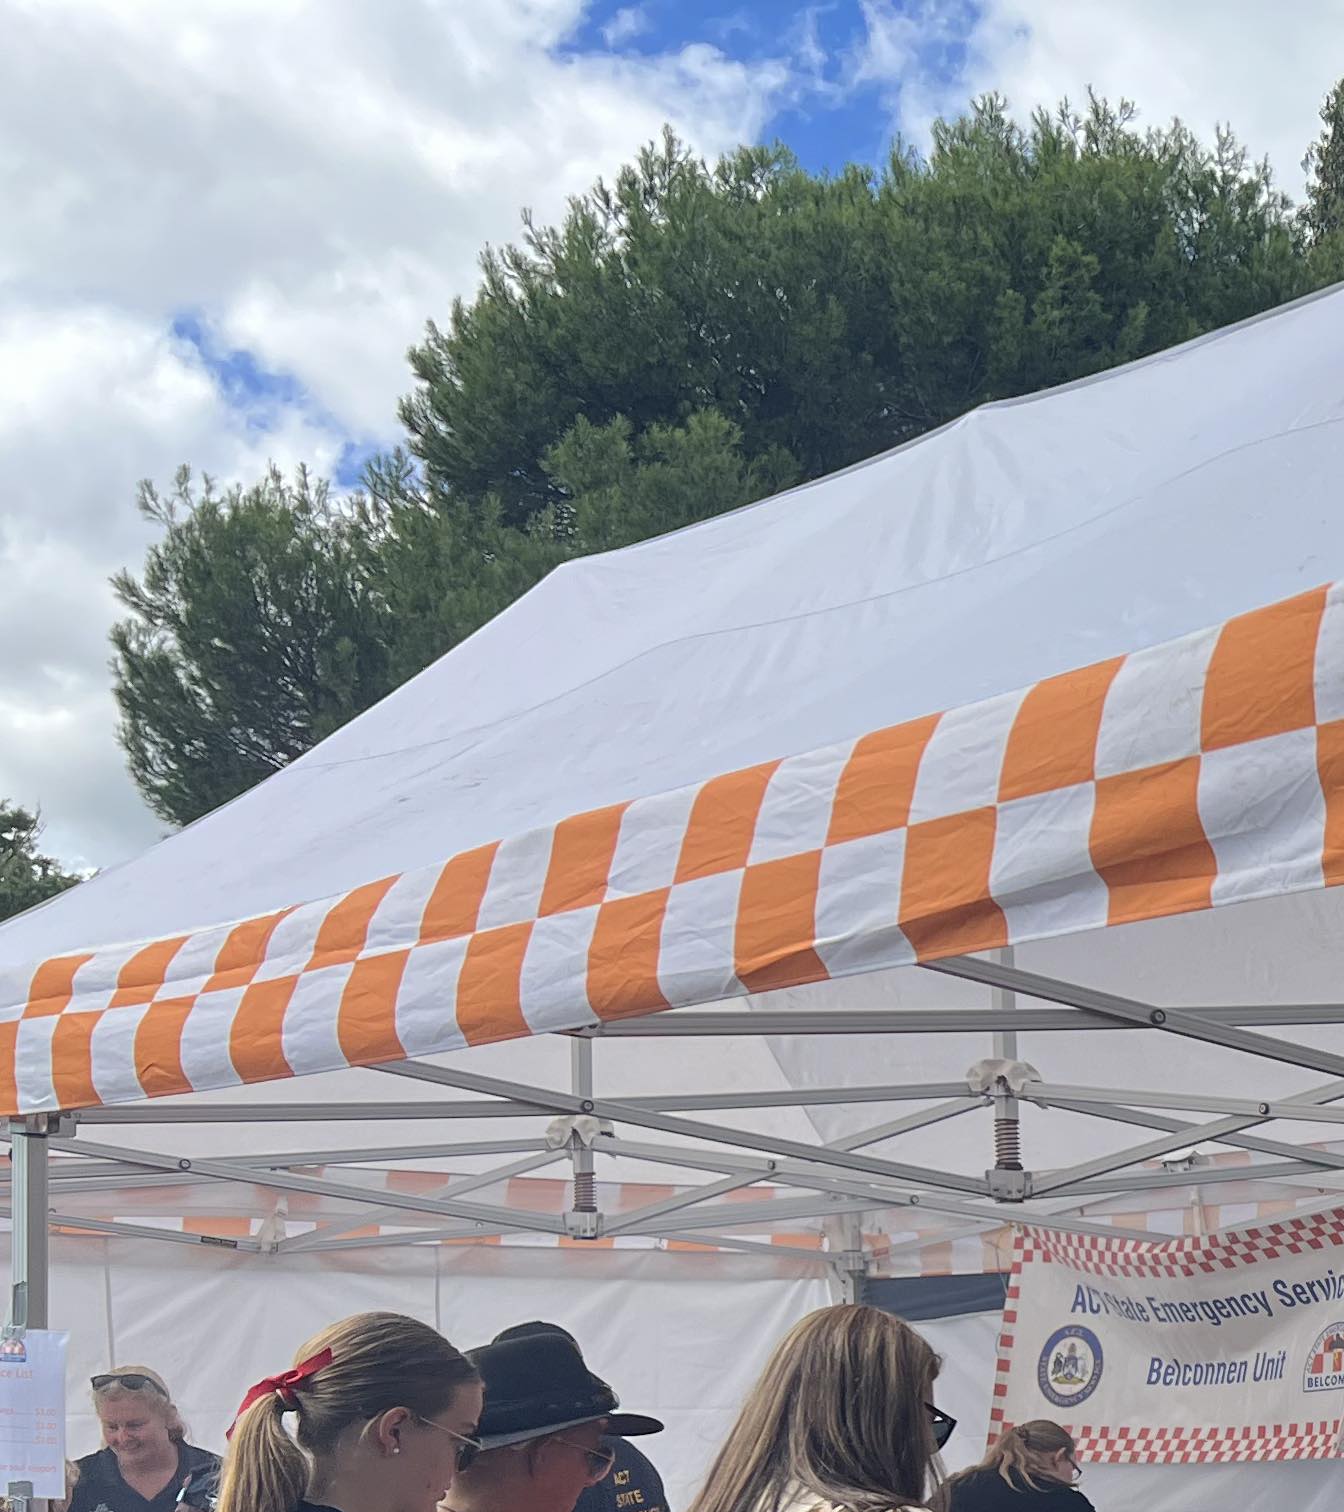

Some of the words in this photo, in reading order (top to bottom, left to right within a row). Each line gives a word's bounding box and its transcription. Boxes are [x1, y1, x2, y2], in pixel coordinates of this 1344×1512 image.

[1150, 1289, 1274, 1326] Emergency
[1147, 1356, 1248, 1387] Belconnen
[1253, 1350, 1287, 1382] Unit
